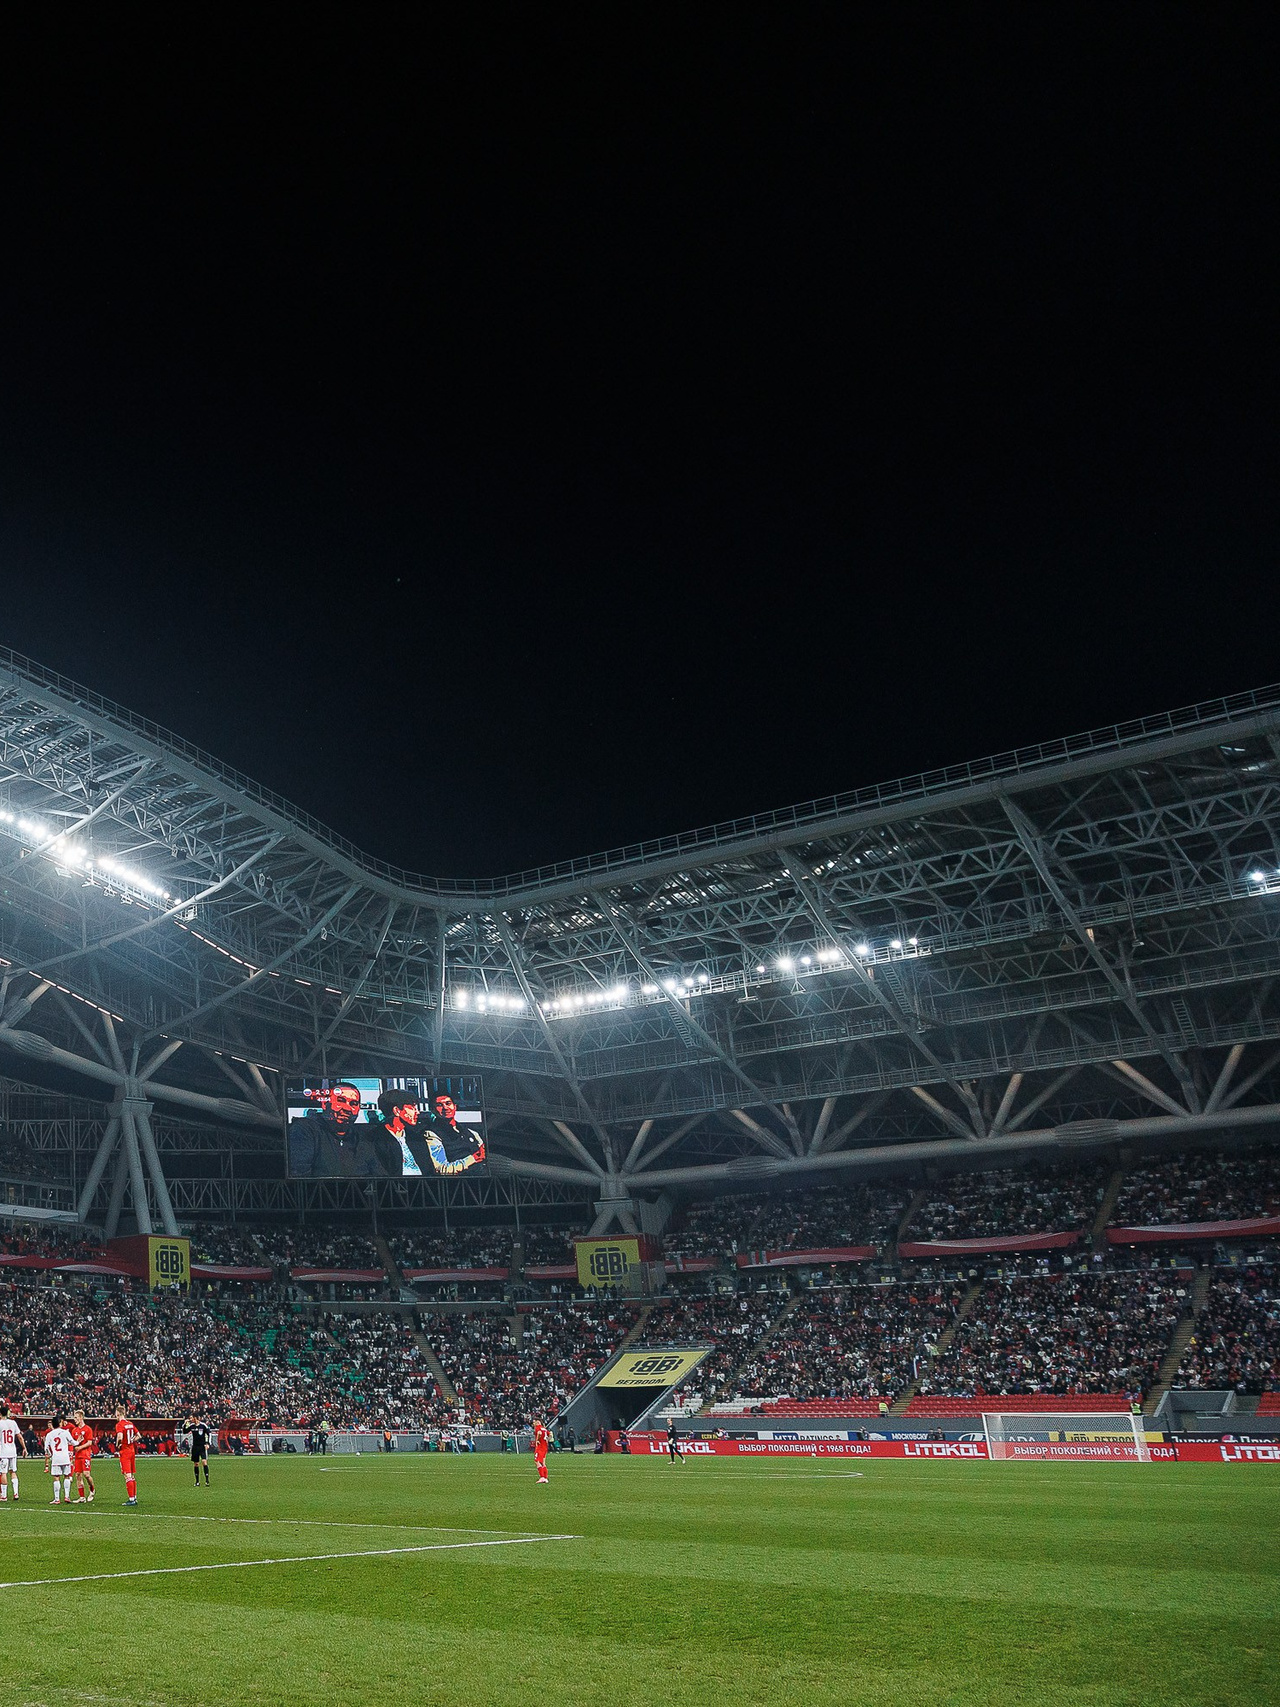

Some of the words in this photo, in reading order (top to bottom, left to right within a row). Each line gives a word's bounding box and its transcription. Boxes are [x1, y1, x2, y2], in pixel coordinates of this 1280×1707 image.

[1, 1429, 14, 1444] 16
[53, 1436, 63, 1452] 2
[738, 1444, 767, 1452] ВЫБОР
[767, 1443, 818, 1453] ПОКОЛЕНИЙ
[826, 1445, 844, 1453] 1968
[845, 1445, 872, 1454] ГОДА!
[903, 1443, 986, 1456] LITOKOL
[1013, 1446, 1049, 1455] ВЫБОР
[1050, 1445, 1112, 1455] ПОКОЛЕНИЙ
